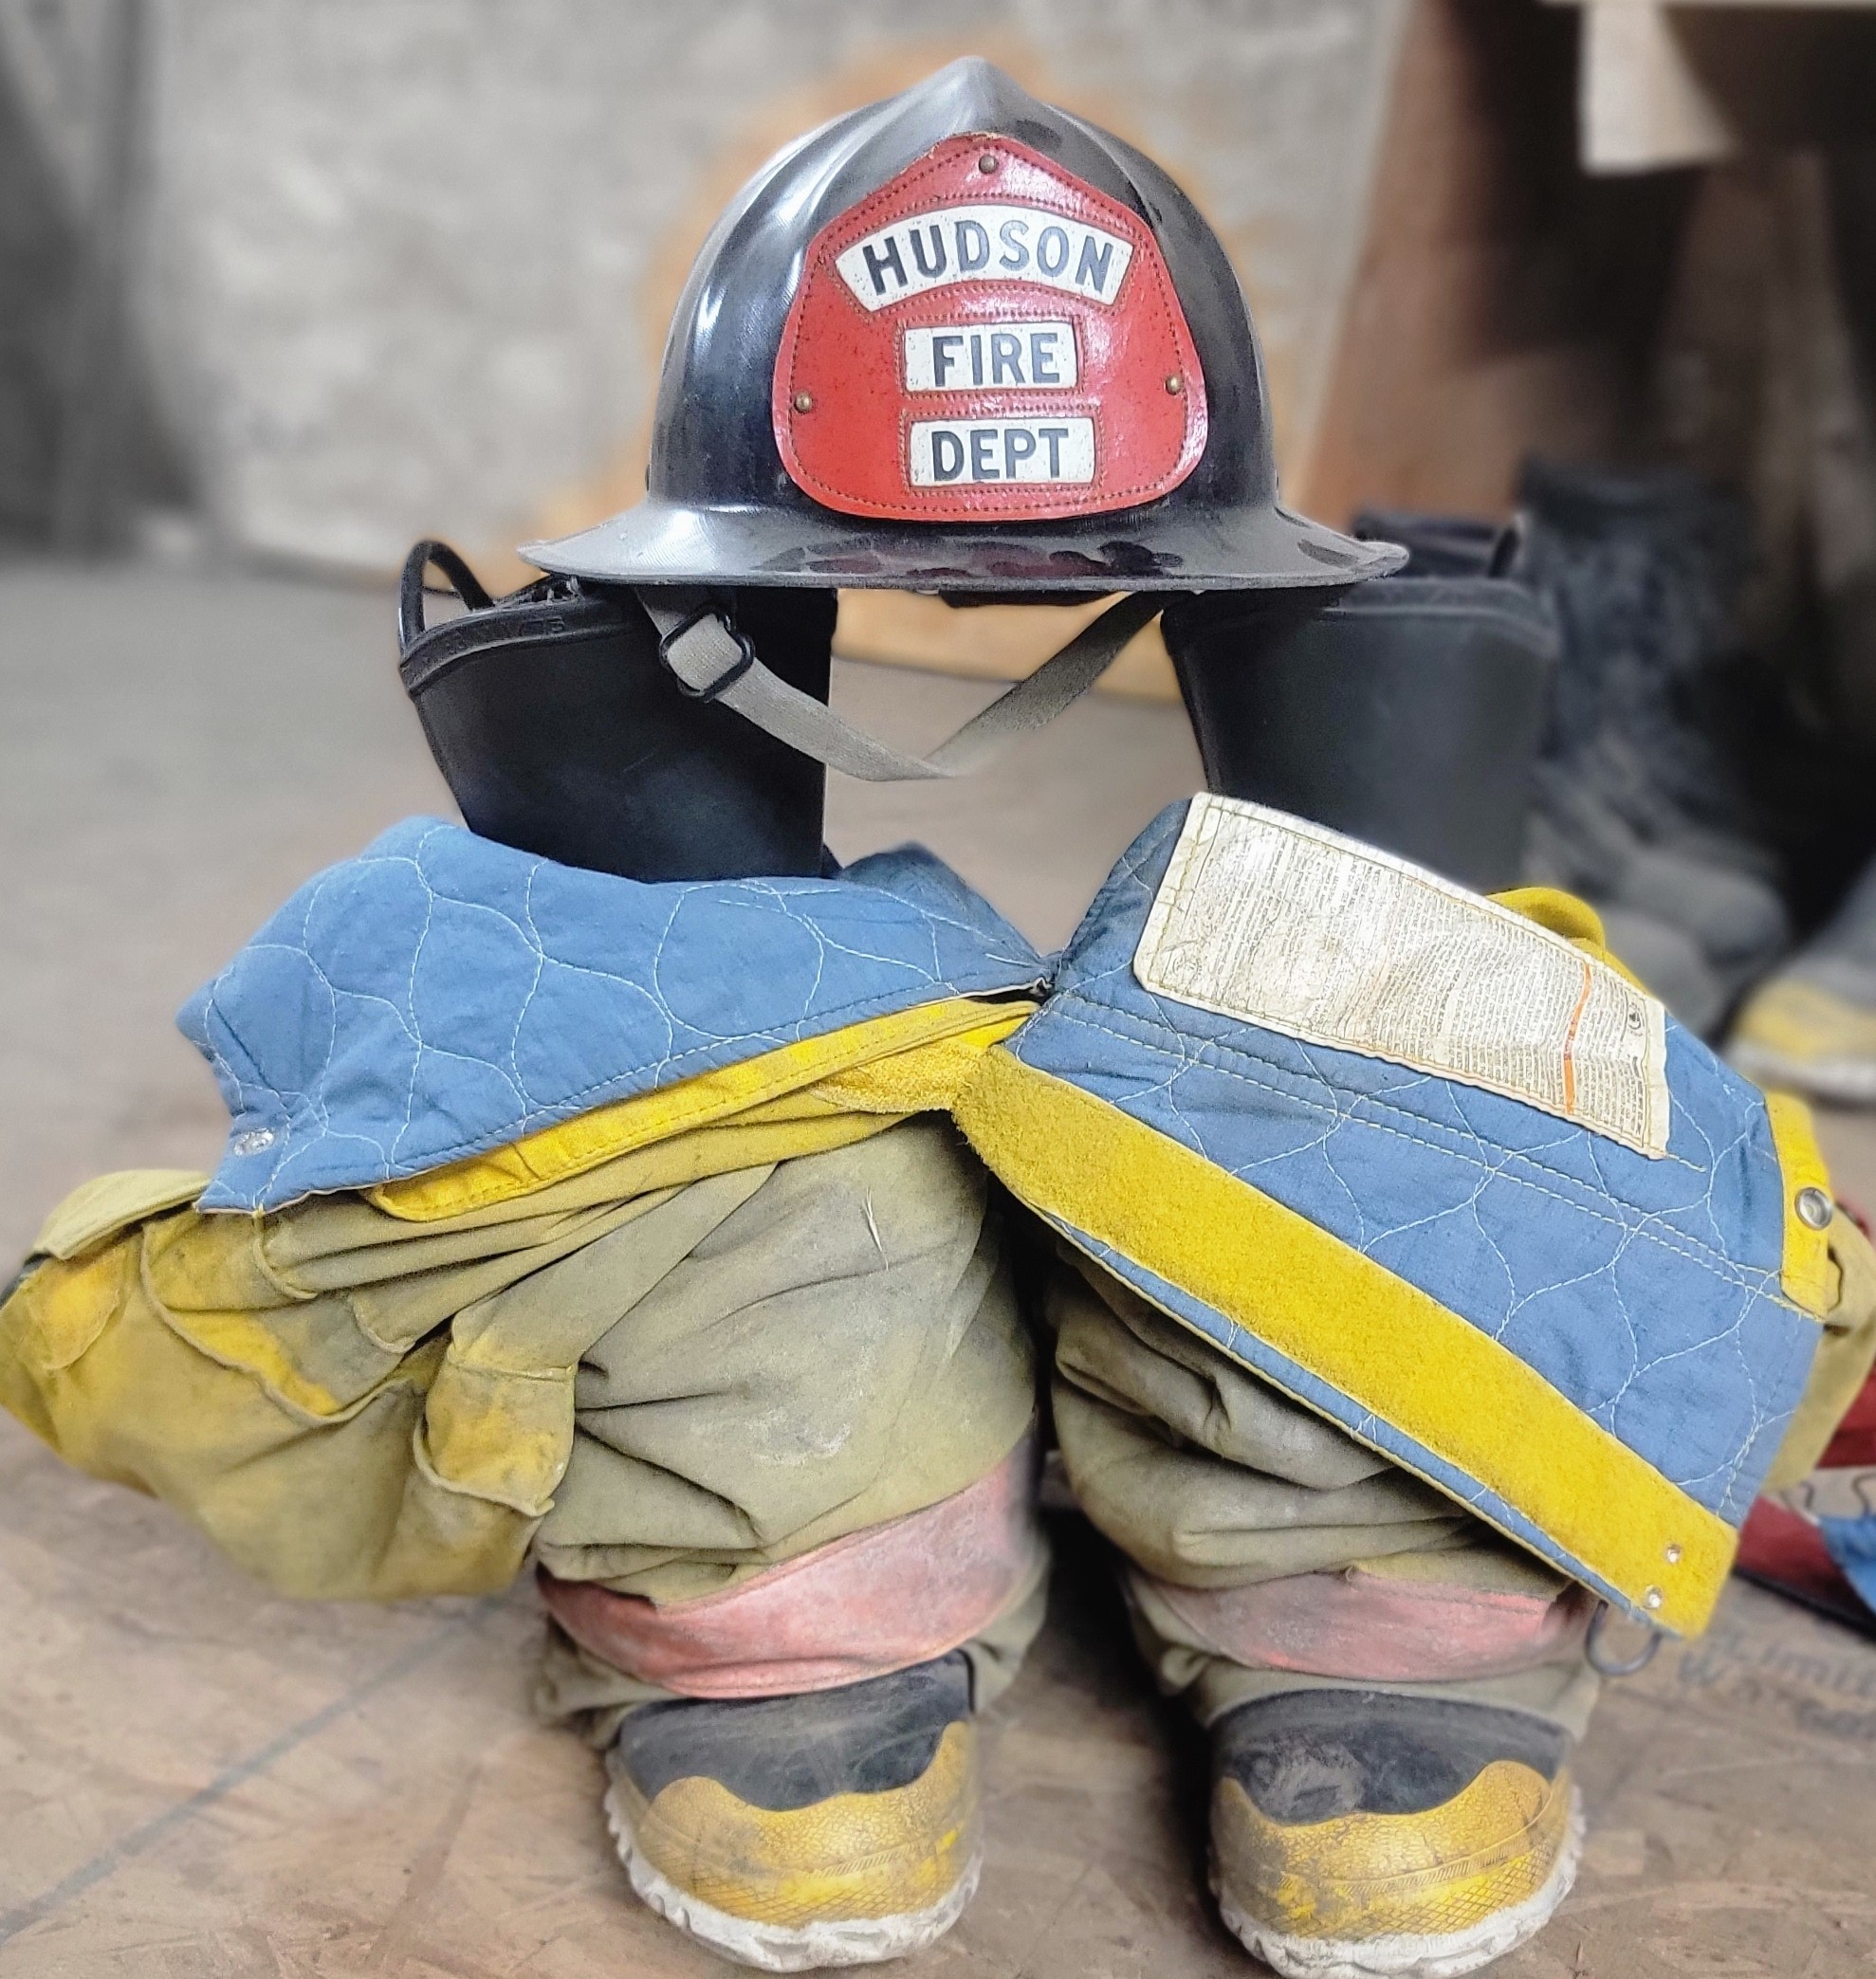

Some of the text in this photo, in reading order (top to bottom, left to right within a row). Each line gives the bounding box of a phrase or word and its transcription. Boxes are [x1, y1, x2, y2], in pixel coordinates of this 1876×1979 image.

[862, 220, 1113, 297] HUDSON
[932, 332, 1060, 388] FIRE
[931, 428, 1069, 482] DEPT
